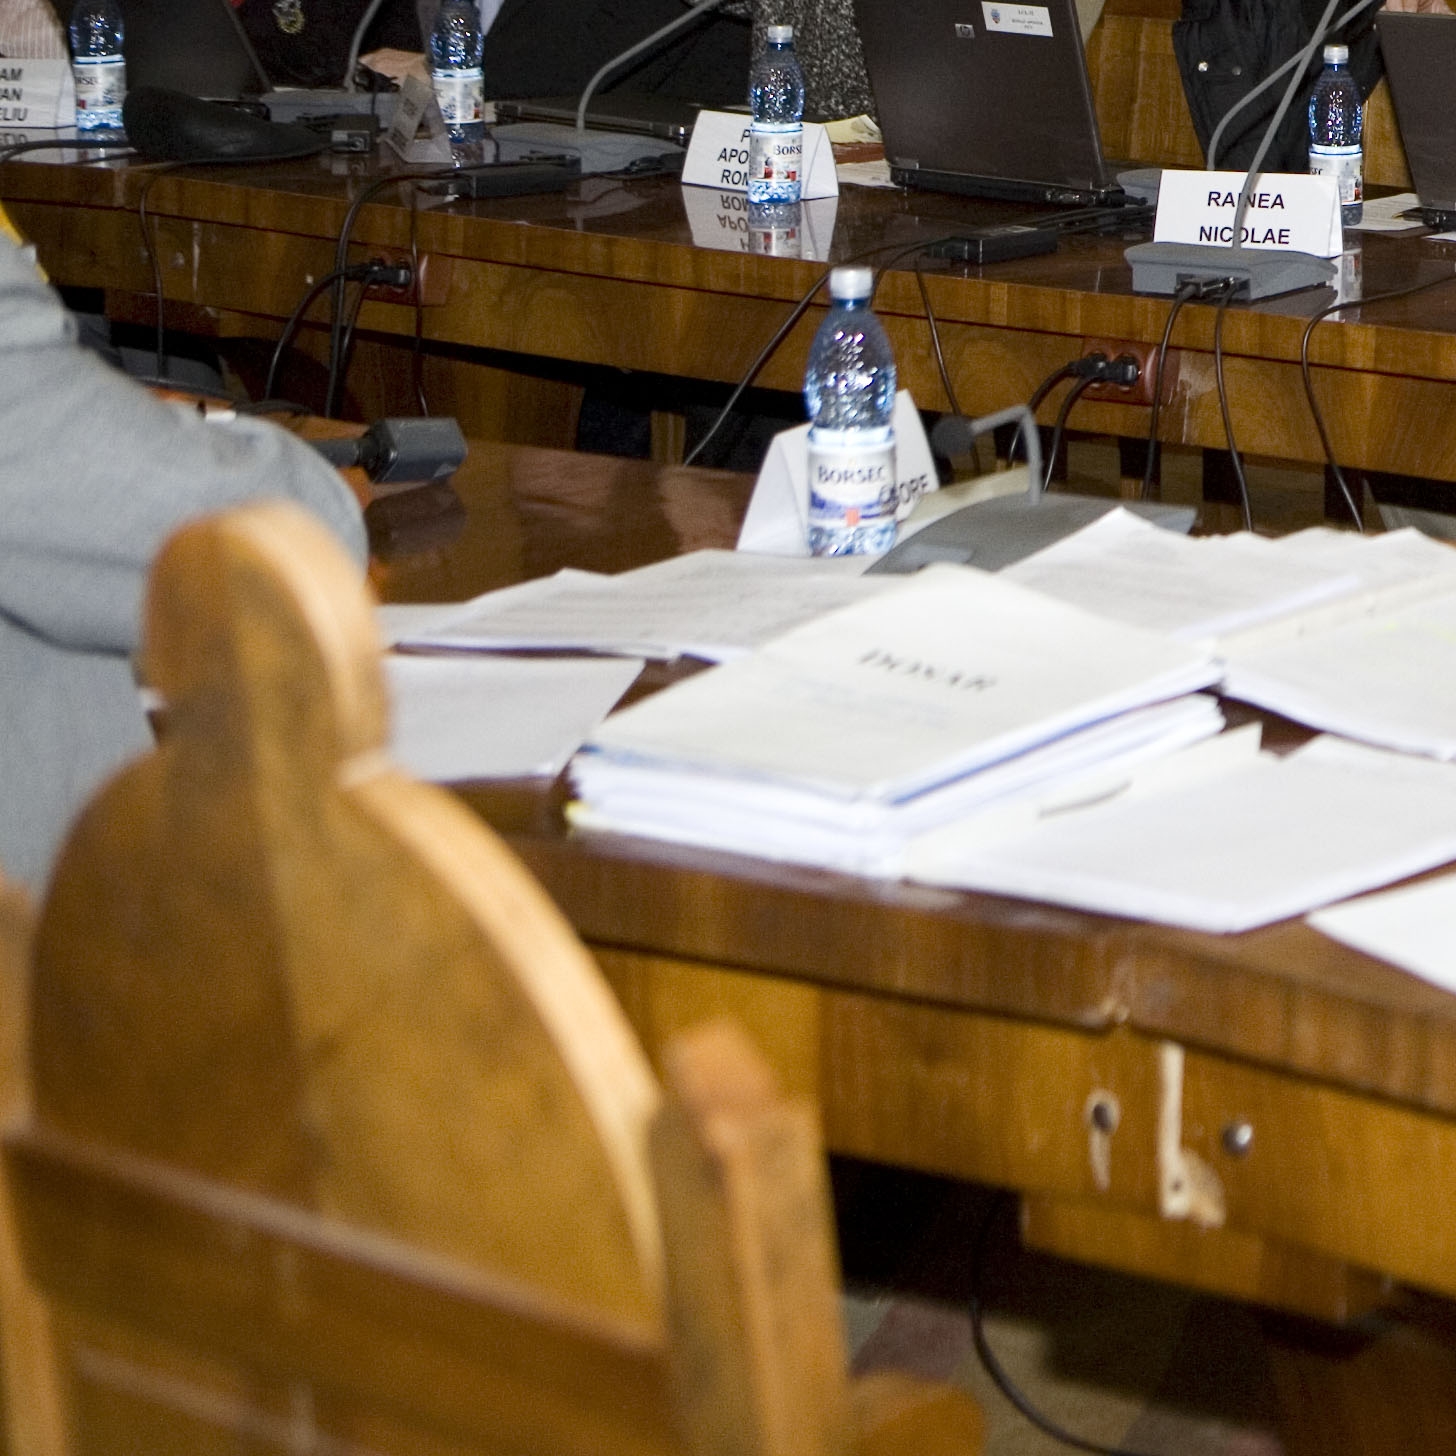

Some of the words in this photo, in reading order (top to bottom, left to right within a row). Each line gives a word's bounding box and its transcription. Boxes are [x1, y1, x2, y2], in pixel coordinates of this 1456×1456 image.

[0, 88, 23, 101] AN
[0, 107, 28, 121] LIU
[1199, 225, 1291, 245] NICOLAE
[818, 464, 884, 484] BORSEC
